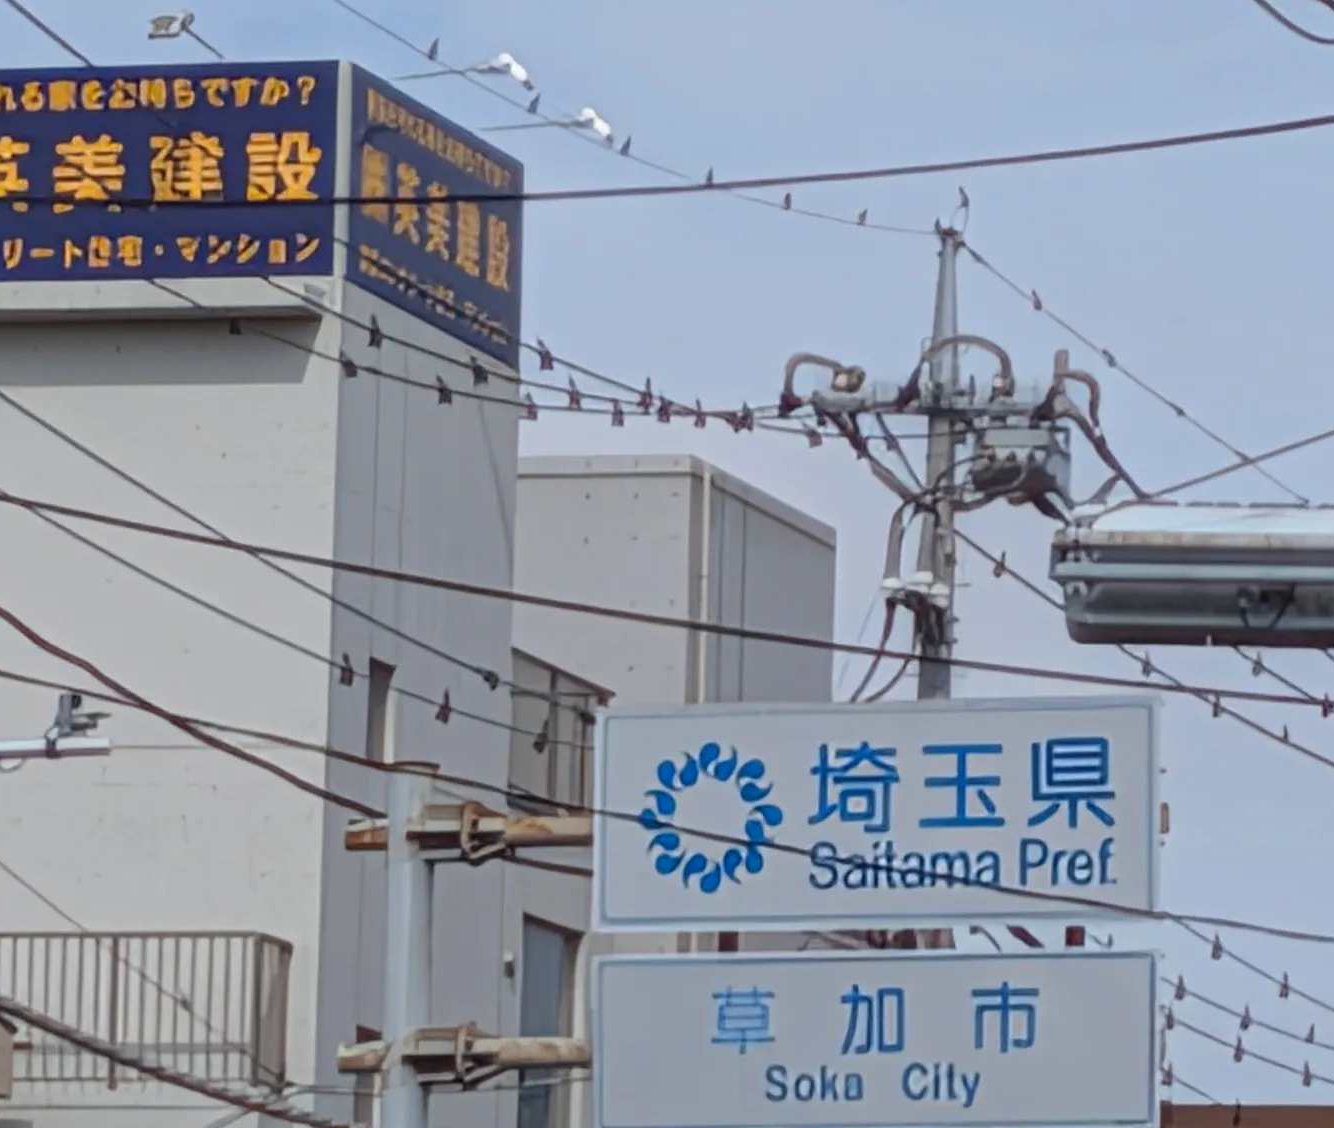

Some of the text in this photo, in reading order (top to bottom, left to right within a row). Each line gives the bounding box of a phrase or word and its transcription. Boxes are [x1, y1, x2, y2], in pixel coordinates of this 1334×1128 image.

[807, 735, 1117, 834] 埼玉県
[808, 836, 1118, 890] Saitama Pref.
[710, 980, 1041, 1056] 草加市
[764, 1061, 982, 1108] Soka City
